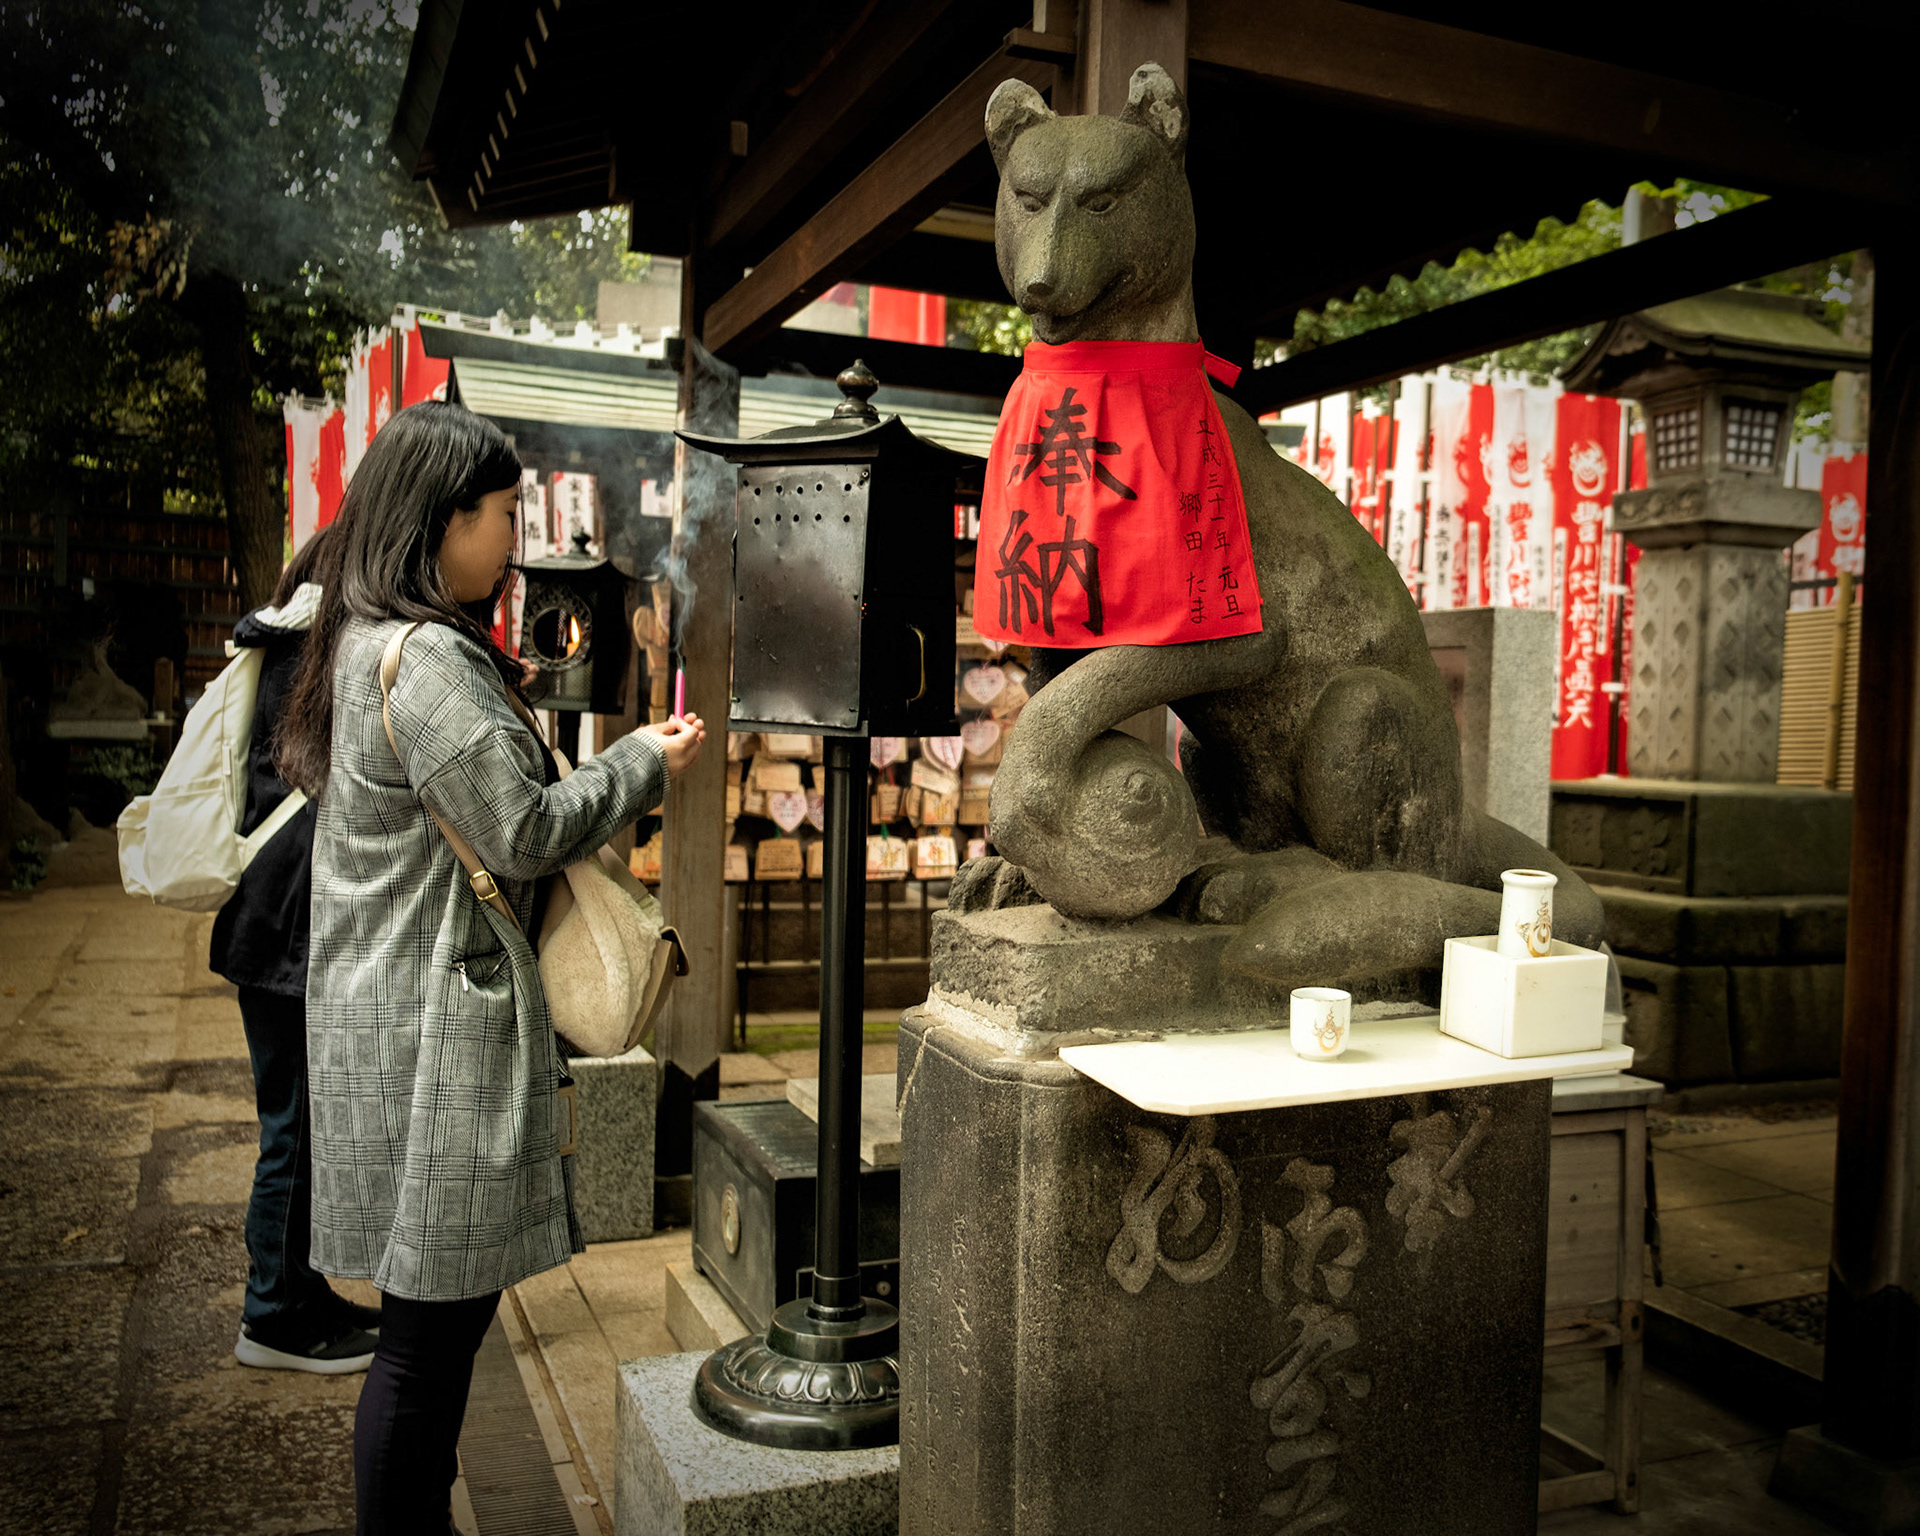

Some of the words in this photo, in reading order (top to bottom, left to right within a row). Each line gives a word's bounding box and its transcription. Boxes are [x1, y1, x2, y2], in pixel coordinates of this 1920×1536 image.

[994, 387, 1137, 636] 奉納
[1196, 419, 1244, 620] 平成三十一年元旦
